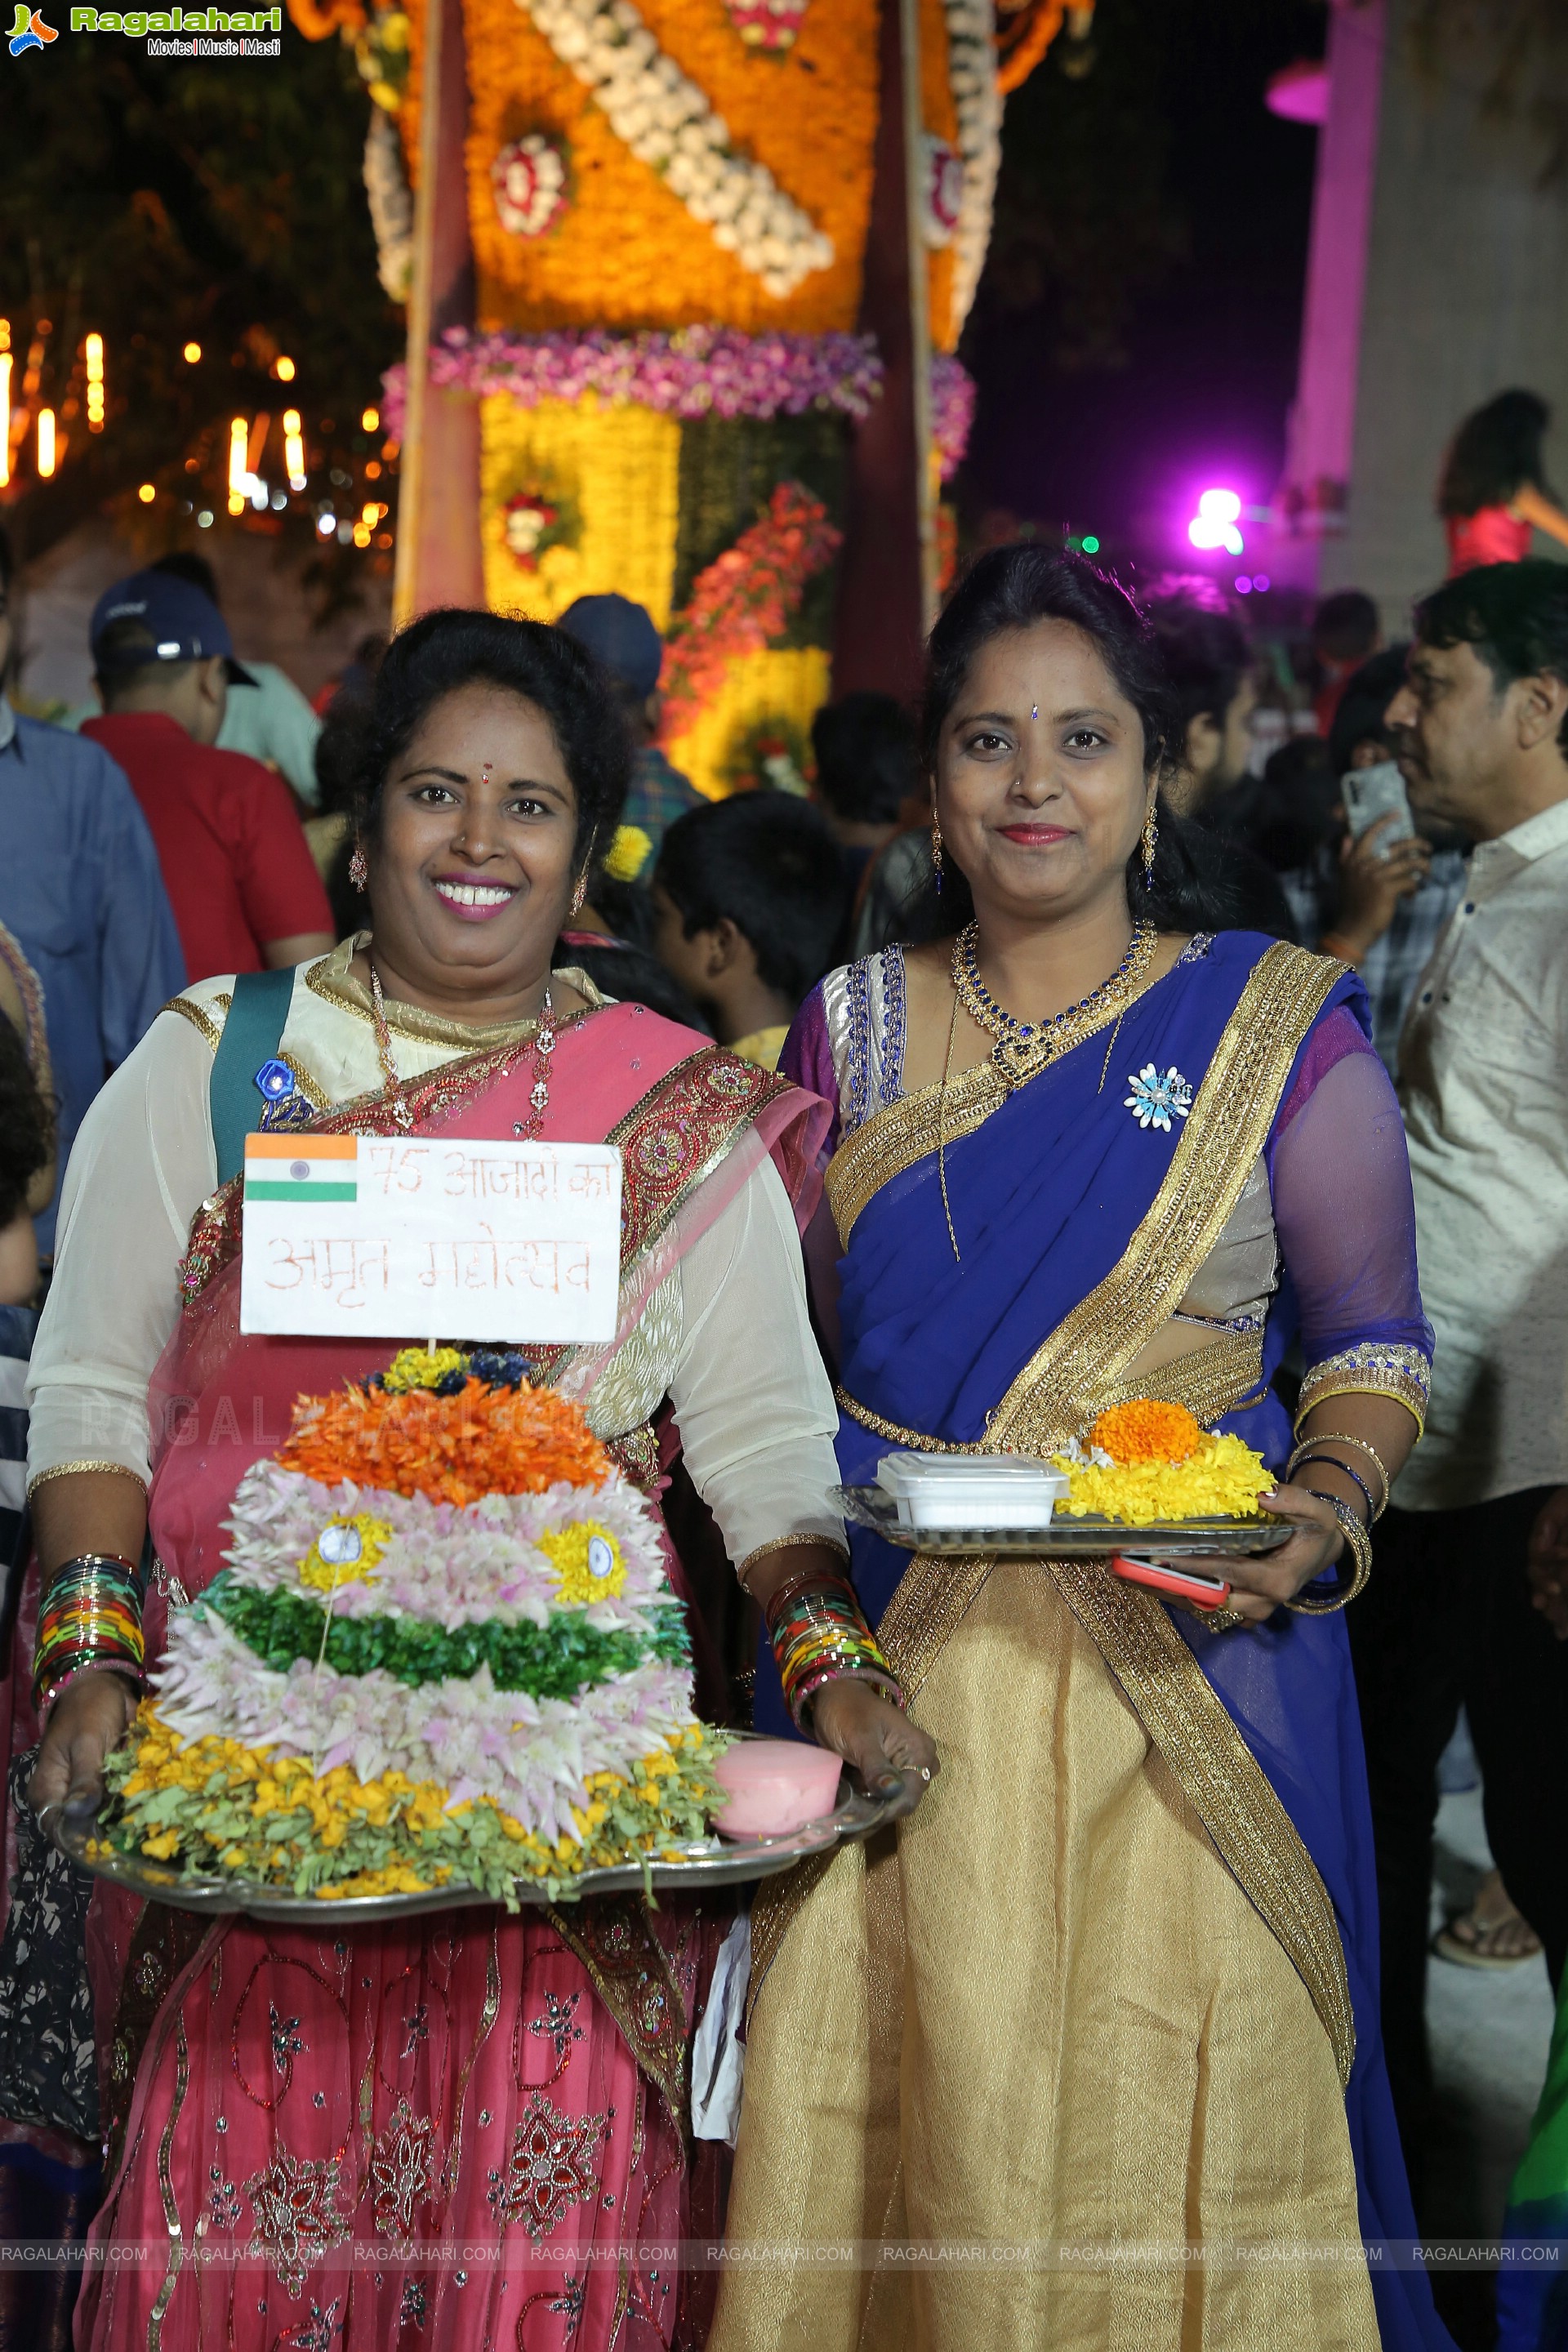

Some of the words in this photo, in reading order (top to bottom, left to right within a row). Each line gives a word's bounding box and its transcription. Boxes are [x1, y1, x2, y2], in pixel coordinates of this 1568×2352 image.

[369, 1147, 430, 1195] 75
[568, 1164, 617, 1200] का
[265, 1237, 391, 1308] अमृत
[418, 1221, 593, 1294] महोत्सव
